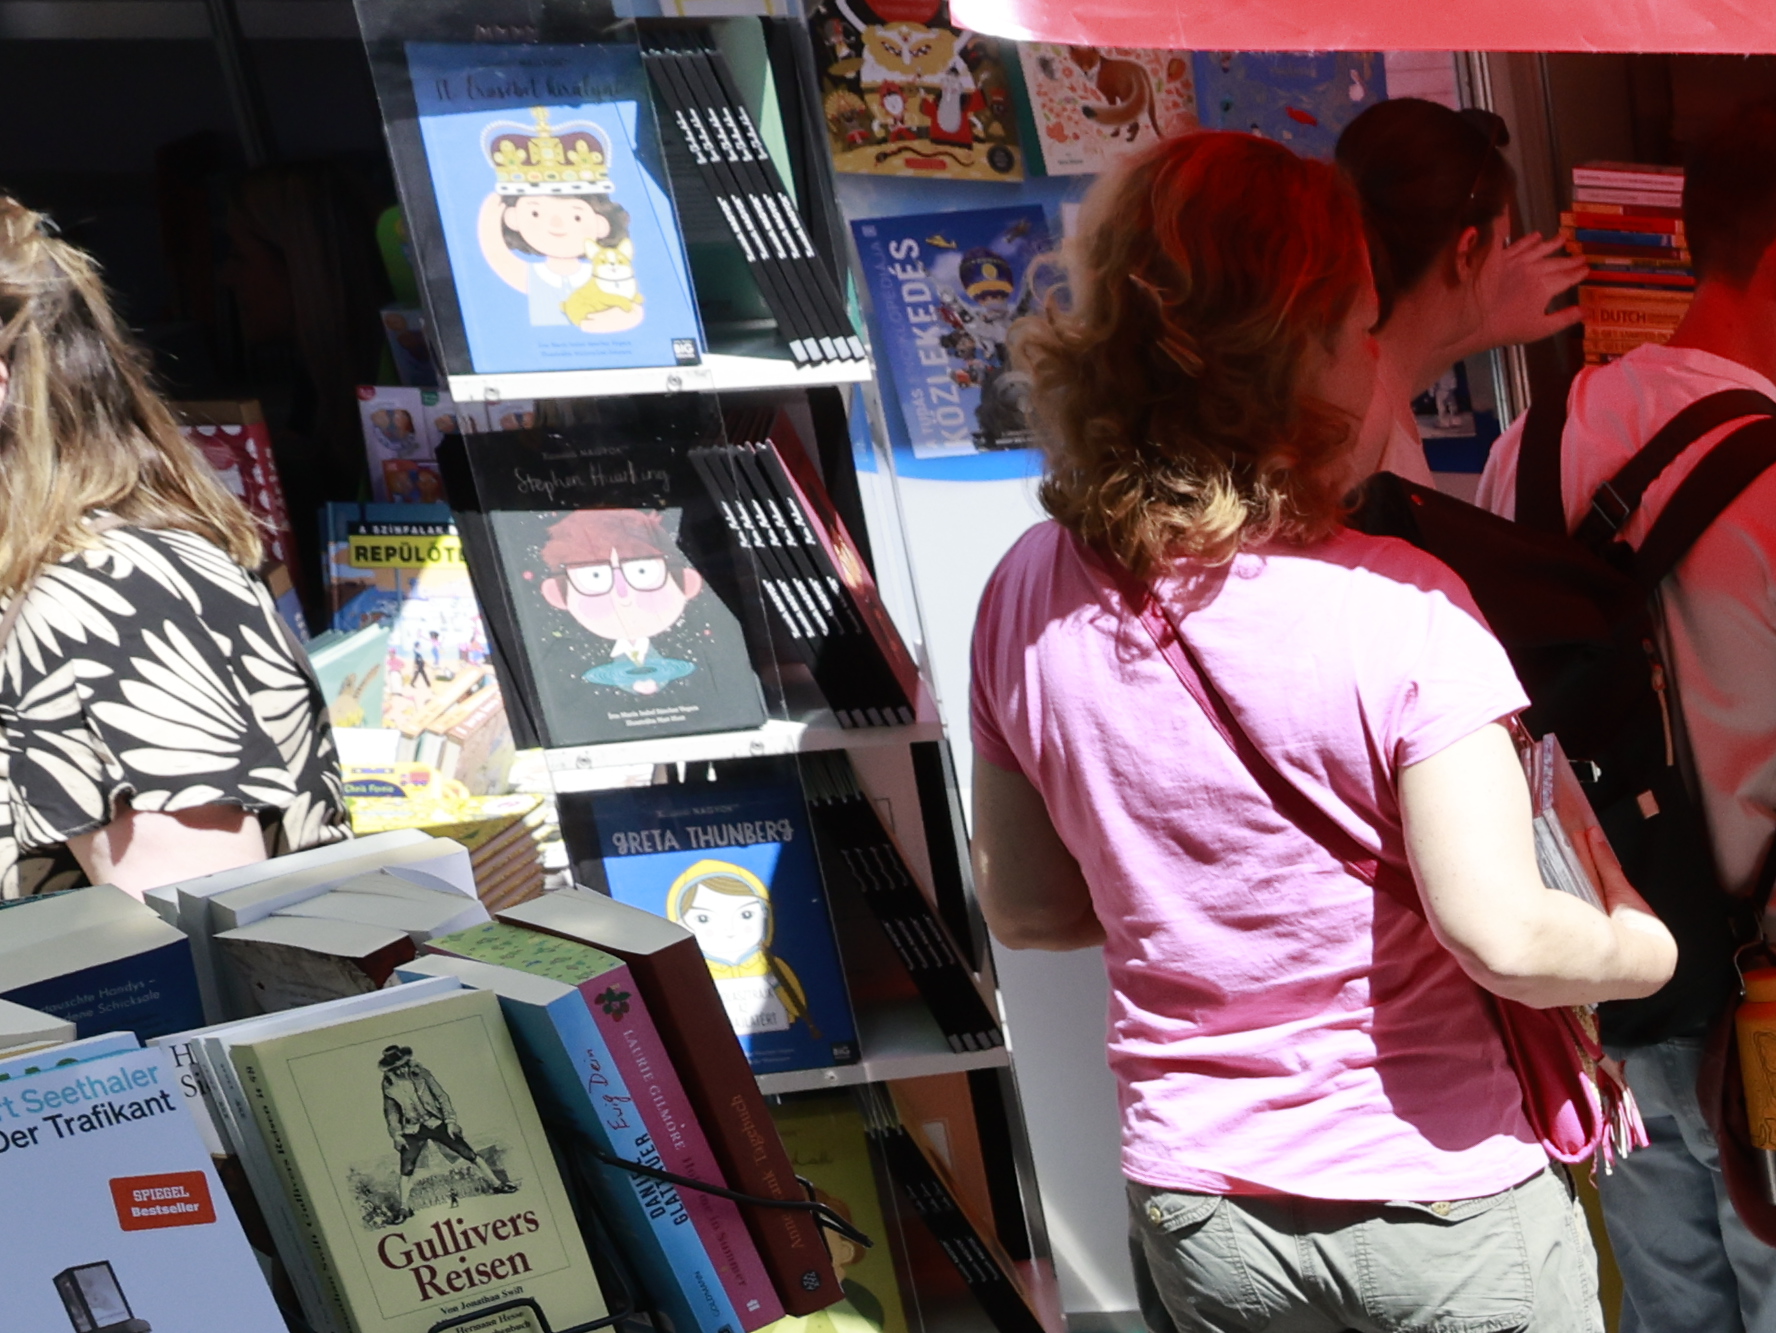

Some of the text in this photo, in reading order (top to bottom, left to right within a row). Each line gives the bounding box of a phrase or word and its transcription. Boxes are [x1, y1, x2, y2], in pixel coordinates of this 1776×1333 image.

[889, 238, 969, 448] KÖZLEKEDÉS
[514, 468, 584, 501] Stephen
[612, 819, 794, 855] GRETA THUNBERG
[25, 1064, 159, 1115] Seethaler
[43, 1090, 176, 1140] Trafikant
[131, 1200, 200, 1217] Bestseller
[132, 1186, 189, 1202] SPIEGEL
[377, 1206, 539, 1270] Gullivers
[410, 1248, 533, 1302] Reisen
